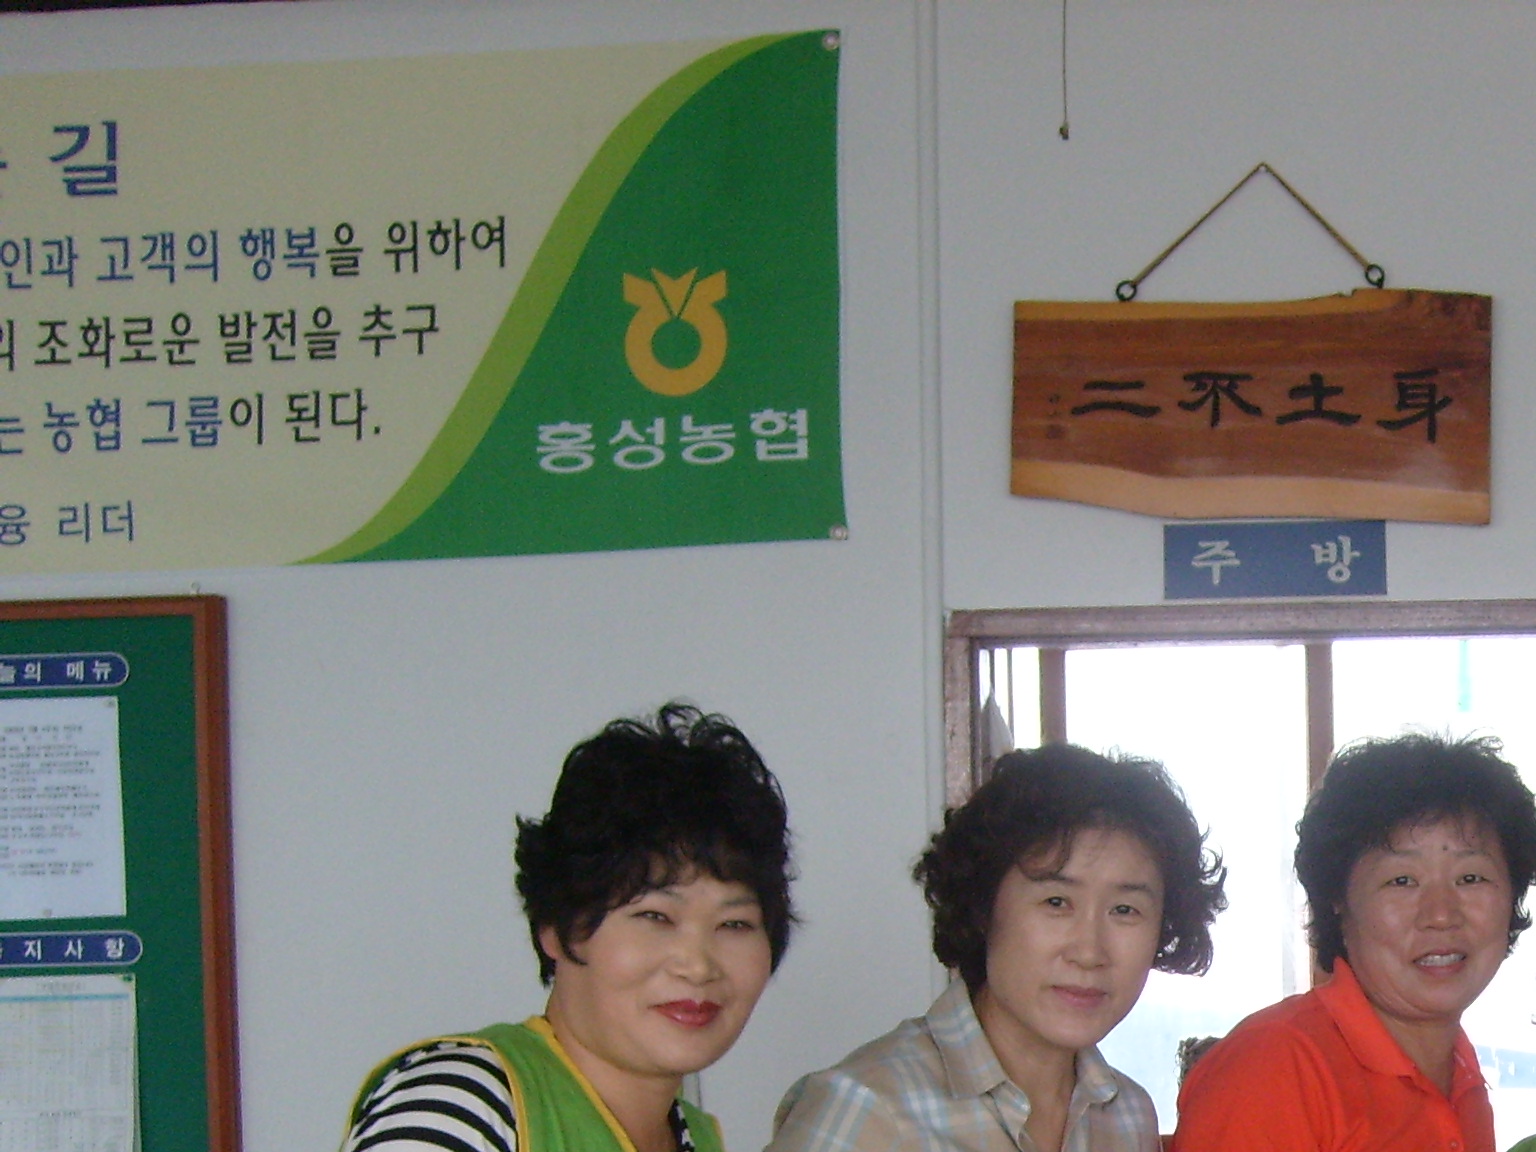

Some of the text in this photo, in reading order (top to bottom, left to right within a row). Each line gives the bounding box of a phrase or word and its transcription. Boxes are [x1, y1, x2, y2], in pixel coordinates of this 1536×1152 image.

[50, 120, 117, 196] 길
[0, 215, 505, 289] 인과 고객의 행복을 위하여
[34, 312, 200, 369] 조화로운
[218, 305, 341, 364] 발전을
[358, 303, 440, 358] 추구
[43, 398, 121, 453] 농협
[141, 391, 264, 448] 그룹이
[284, 387, 381, 442] 된다.
[536, 408, 810, 474] 홍성농협
[58, 500, 134, 543] 리더
[65, 660, 113, 683] 메뉴
